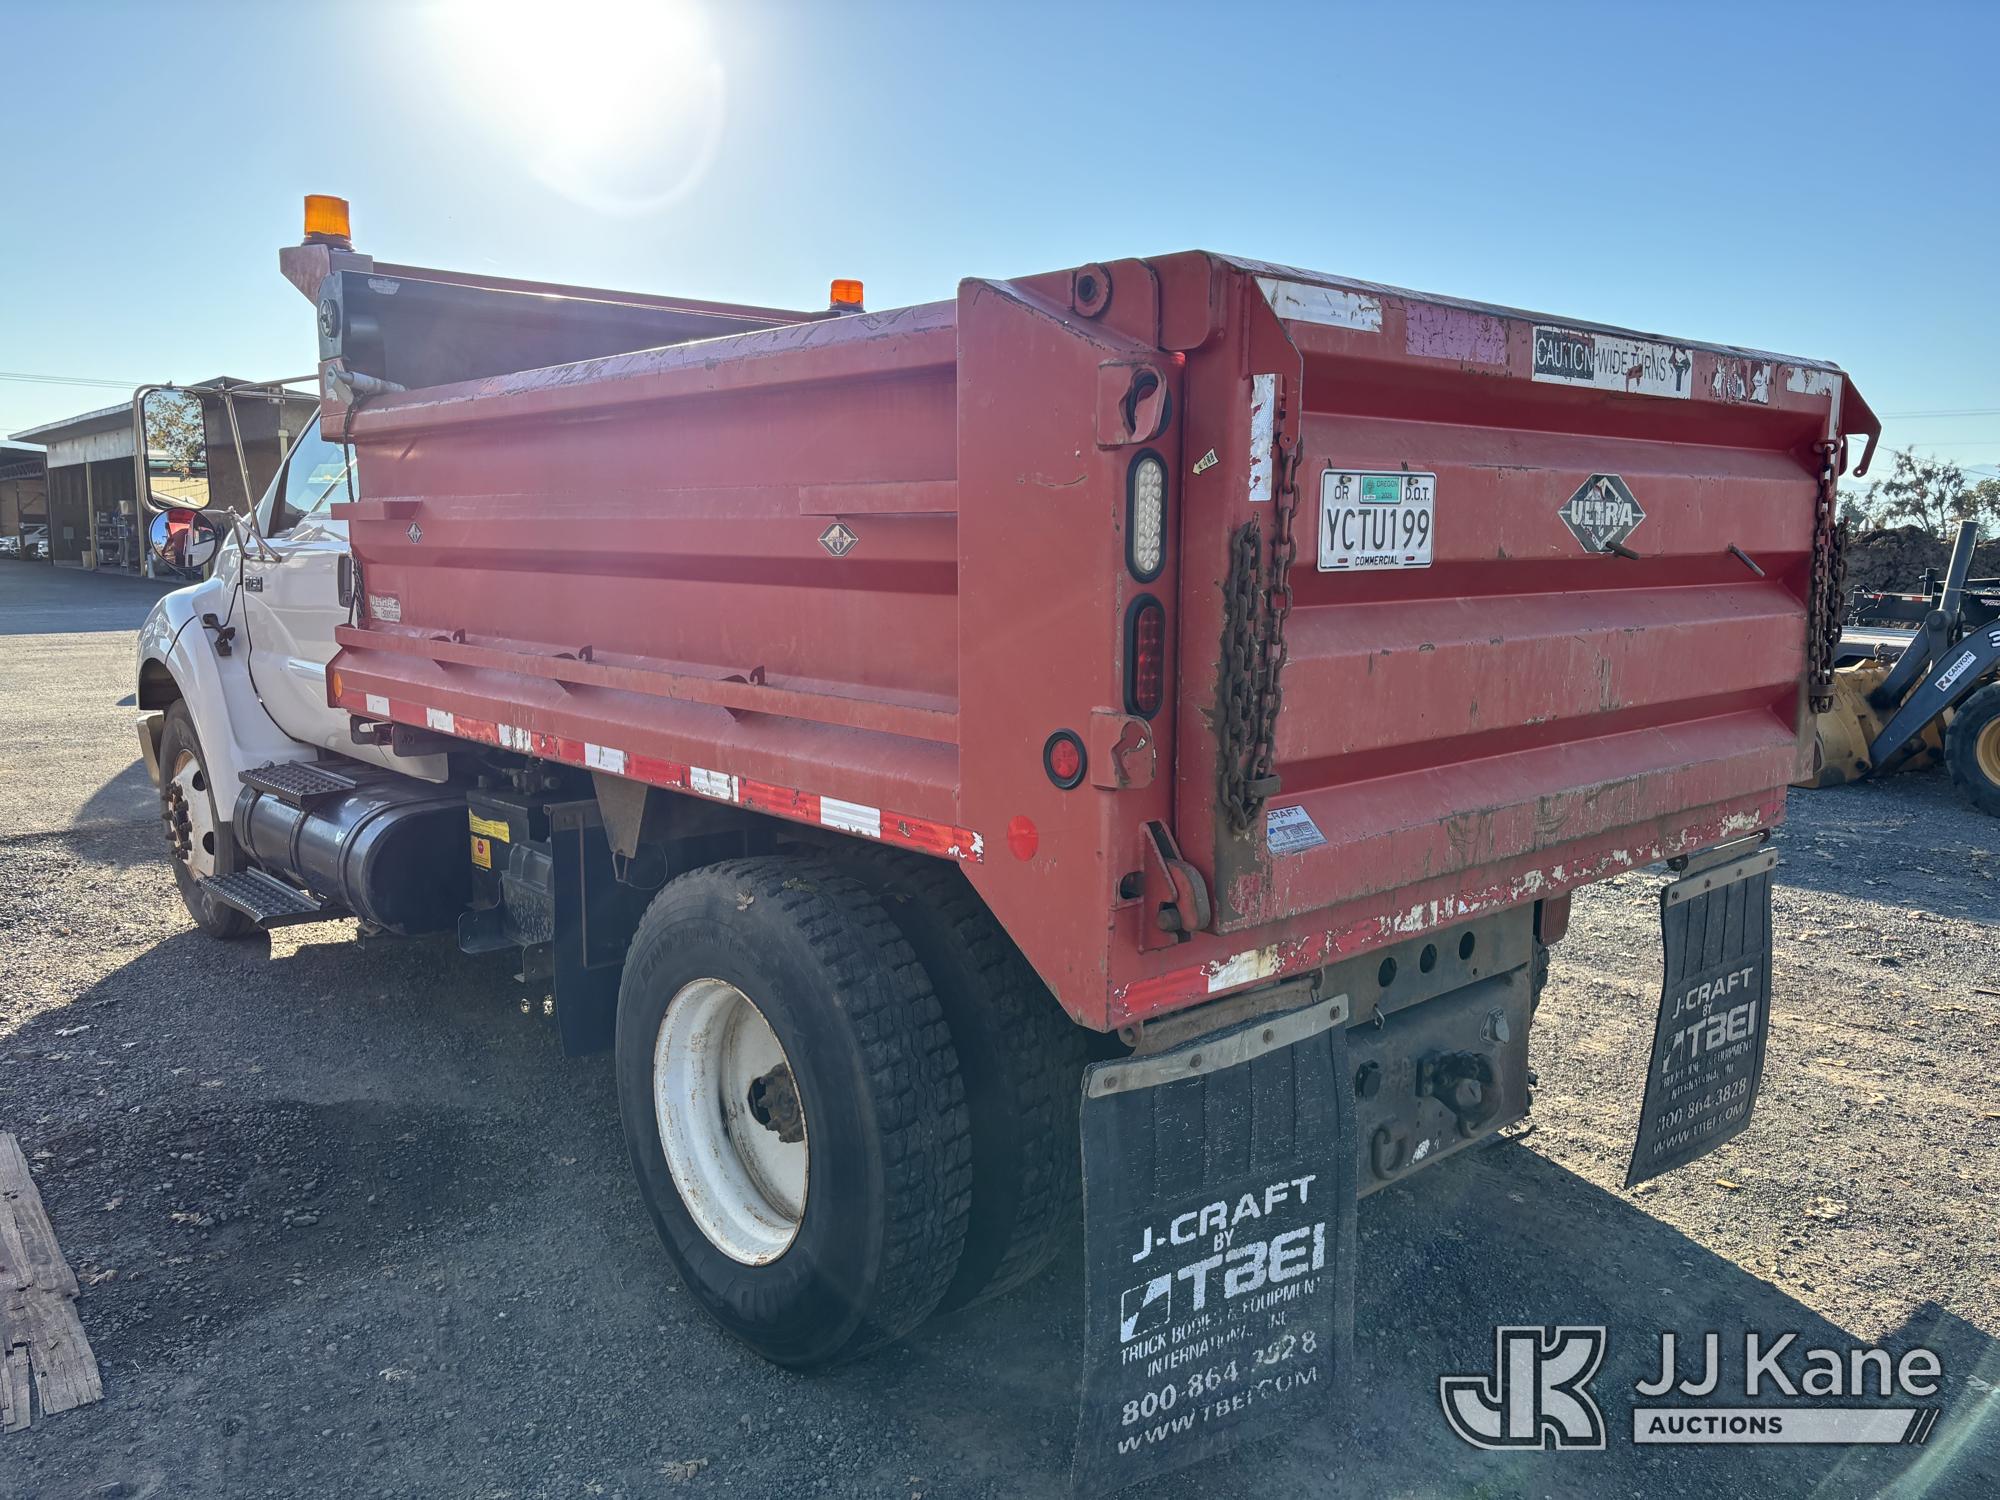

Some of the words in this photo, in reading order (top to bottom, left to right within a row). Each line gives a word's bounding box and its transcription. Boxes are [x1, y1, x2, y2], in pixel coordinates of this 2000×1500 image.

[1537, 337, 1594, 372] CAUTION
[1598, 346, 1628, 376] WIDE
[1334, 485, 1350, 500] OR
[1405, 486, 1430, 501] D.O.T.
[1570, 500, 1634, 527] ULTRA
[1326, 508, 1430, 551] YCTU199
[1354, 555, 1399, 567] COMMERCIAL
[1947, 652, 1972, 677] CANYON
[1702, 1002, 1713, 1017] BY
[1686, 1000, 1756, 1058] TBEI
[1213, 1228, 1235, 1252] BY
[1177, 1222, 1326, 1312] TBEI
[1120, 1333, 1167, 1366] TRUCK
